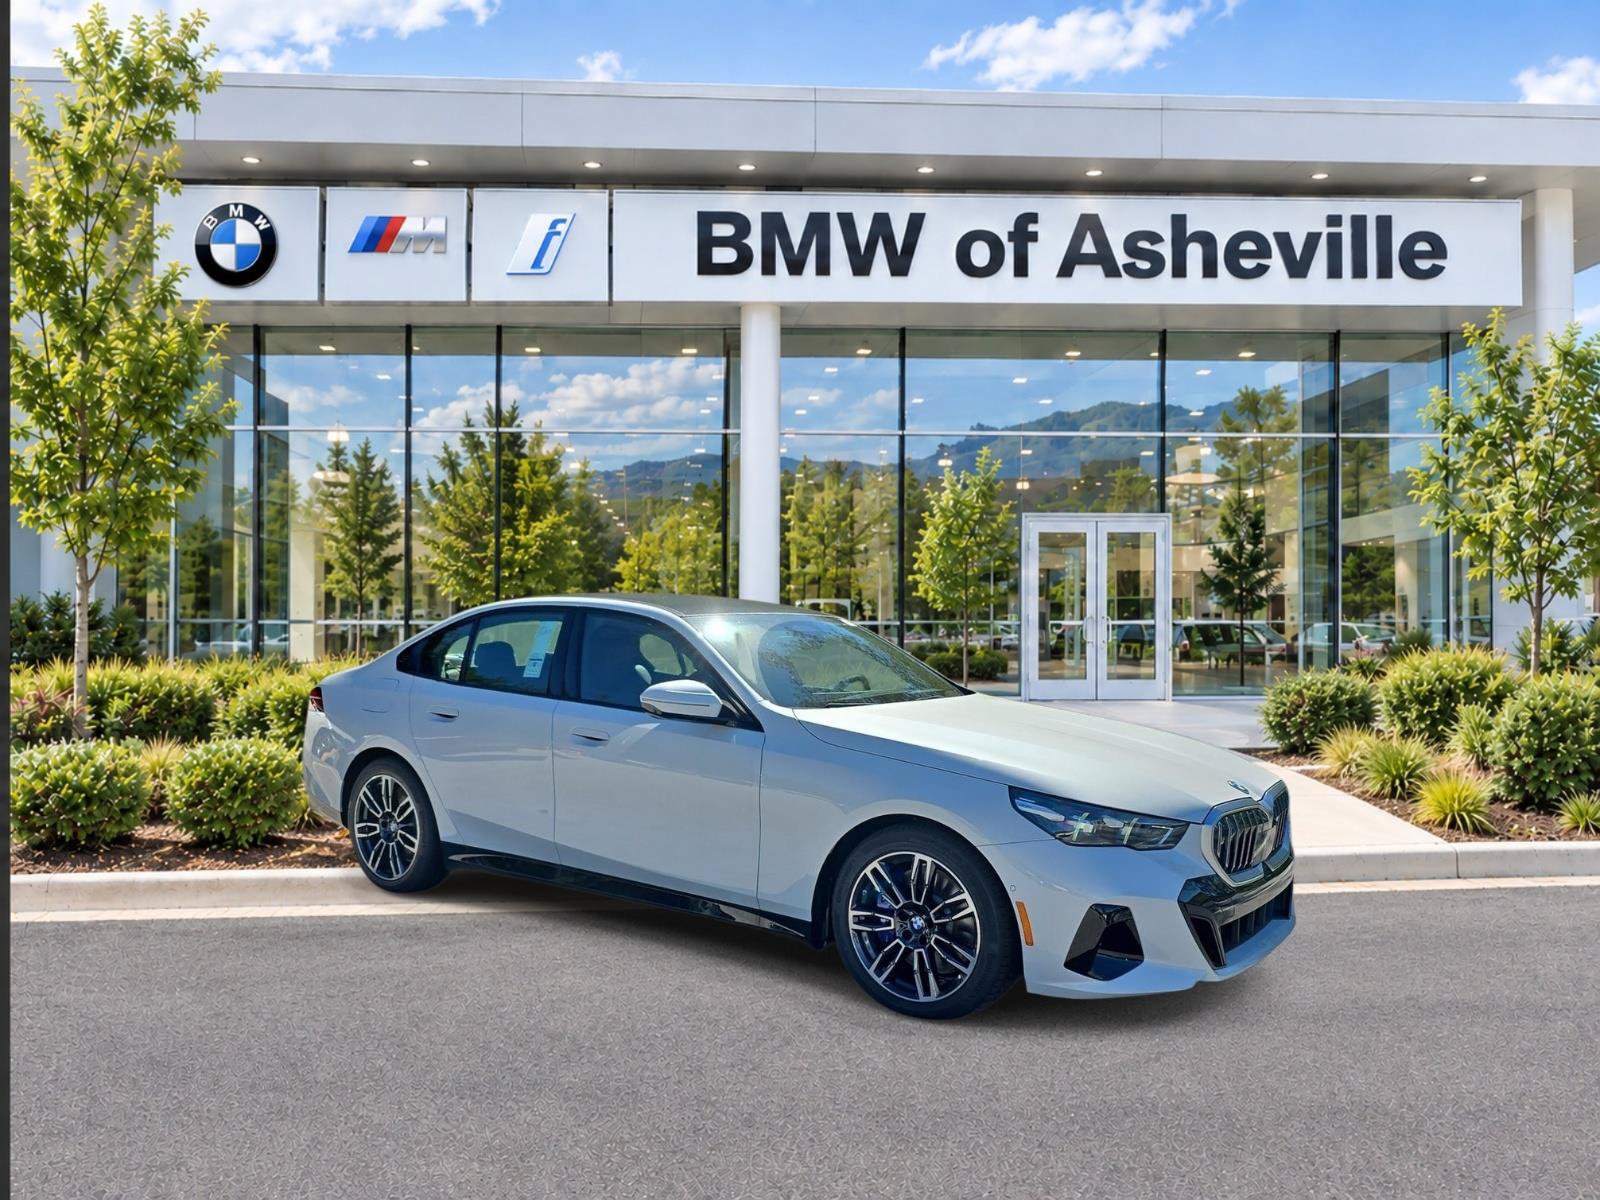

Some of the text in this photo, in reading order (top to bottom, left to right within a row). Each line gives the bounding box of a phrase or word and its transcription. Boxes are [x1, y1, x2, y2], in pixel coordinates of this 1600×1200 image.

[203, 204, 271, 231] BMW
[389, 215, 447, 254] M
[696, 210, 1448, 281] BMW of Asheville
